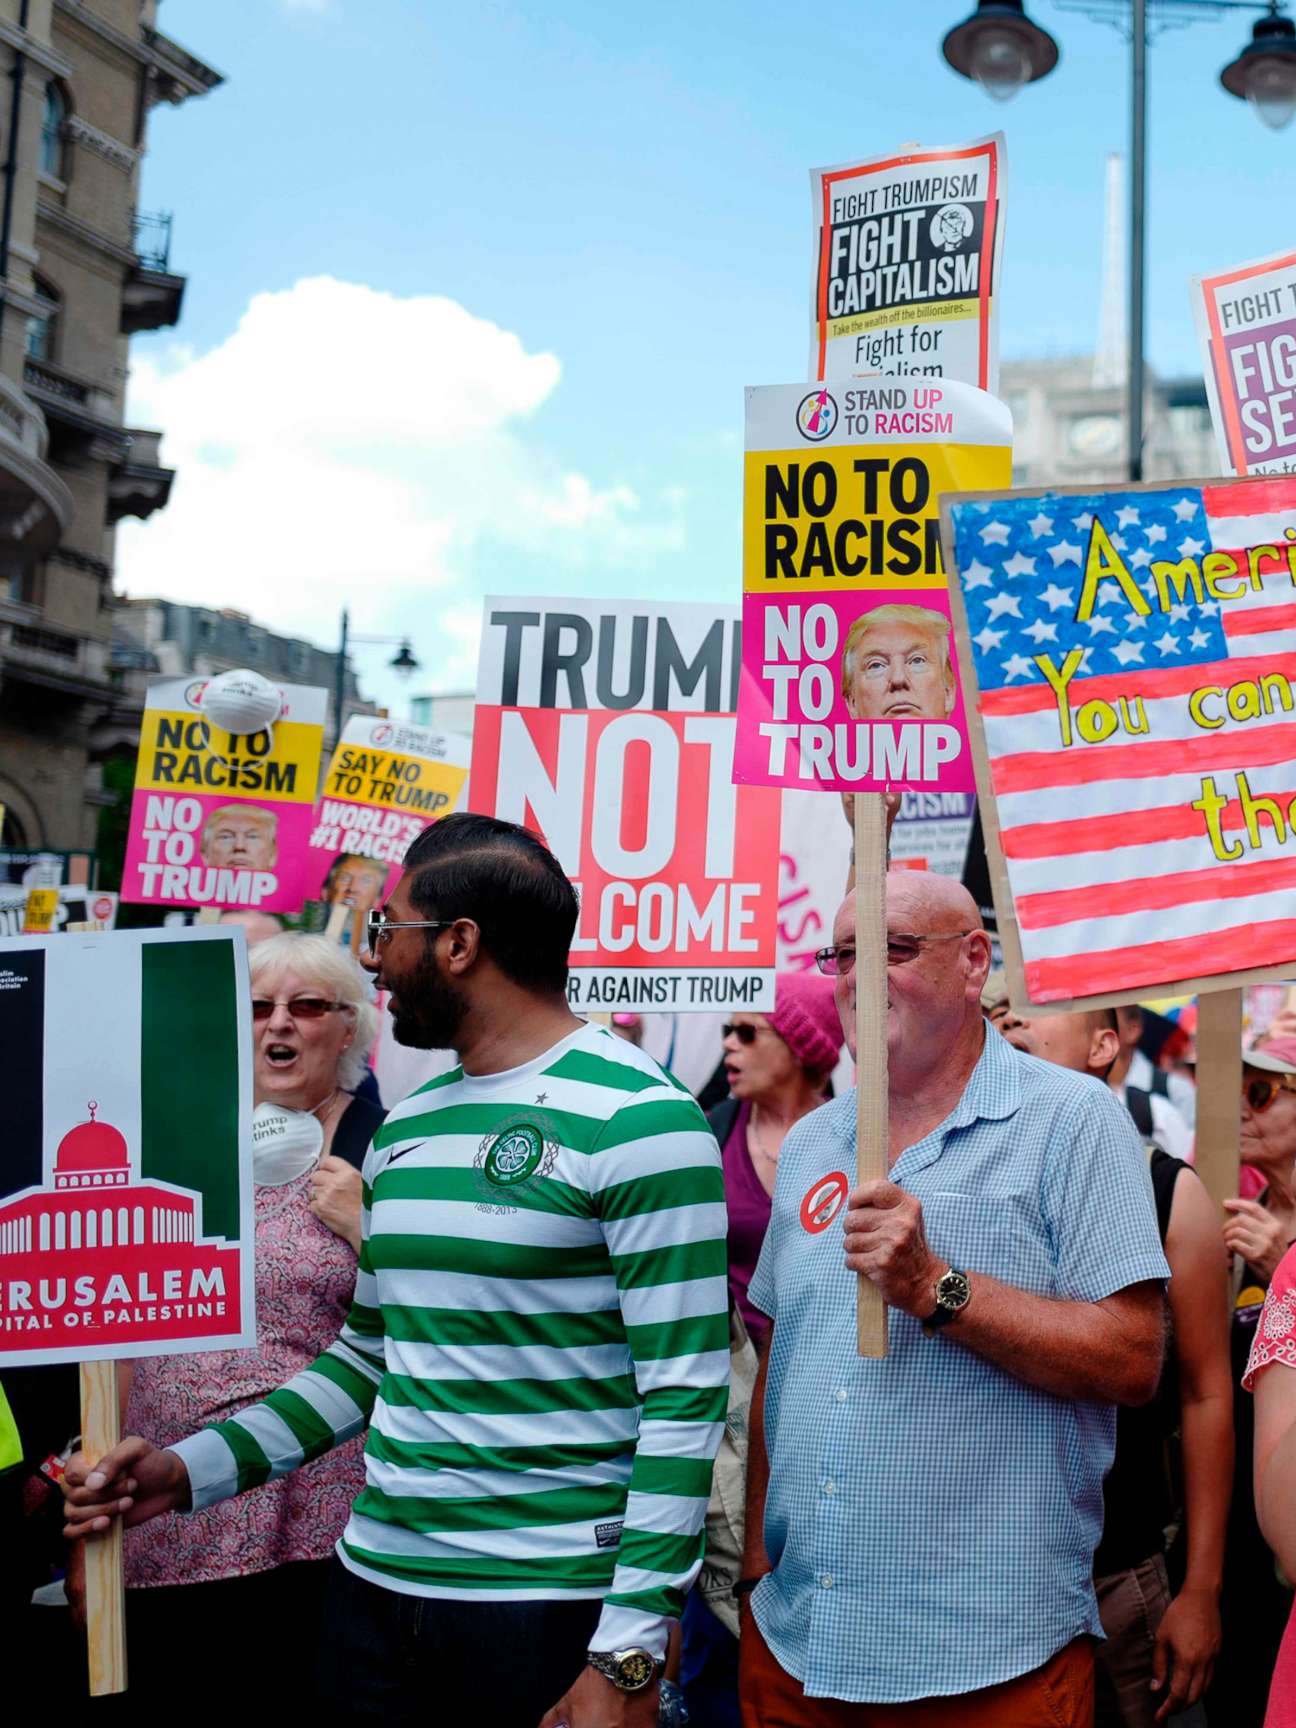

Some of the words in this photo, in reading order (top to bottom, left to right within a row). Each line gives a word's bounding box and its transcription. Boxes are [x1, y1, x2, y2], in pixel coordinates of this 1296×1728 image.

[832, 191, 879, 223] FIGHT
[882, 173, 979, 212] TRUMPISM
[830, 209, 926, 279] FIGHT
[828, 252, 979, 317] CAPITALISM
[833, 321, 851, 337] Take
[851, 319, 864, 333] the
[901, 309, 916, 323] the
[1221, 287, 1284, 328] FIGHT
[855, 328, 904, 367] Fight
[910, 325, 943, 353] for
[845, 389, 907, 411] STAND
[914, 388, 943, 410] UP
[845, 414, 869, 436] TO
[875, 412, 953, 435] RACISM
[765, 461, 838, 519] NO
[854, 457, 930, 515] TO
[764, 603, 838, 662] NO
[763, 664, 834, 721] TO
[1032, 649, 1150, 748] You
[1189, 671, 1295, 730] can
[156, 718, 211, 750] NO
[758, 722, 961, 782] TRUMP
[152, 751, 298, 793] RACISM
[339, 751, 381, 774] SAY
[387, 760, 421, 782] NO
[333, 772, 361, 796] TO
[367, 779, 449, 813] TRUMP
[495, 711, 737, 881] NOT
[903, 793, 967, 819] CISM
[145, 795, 203, 832] NO
[320, 801, 424, 841] WORLD'S
[142, 831, 194, 865] TO
[309, 832, 338, 851] #1
[340, 835, 412, 863] RACIS
[138, 863, 278, 905] TRUMP
[568, 882, 761, 953] LCOME
[586, 976, 681, 1004] AGAINST
[687, 976, 764, 1004] TRUMP
[252, 1126, 285, 1142] tinks
[253, 1116, 288, 1131] rump
[0, 1267, 226, 1312] RUSALEM
[0, 1316, 52, 1331] ITAL
[64, 1311, 92, 1328] OF
[104, 1301, 226, 1325] PALESTINE
